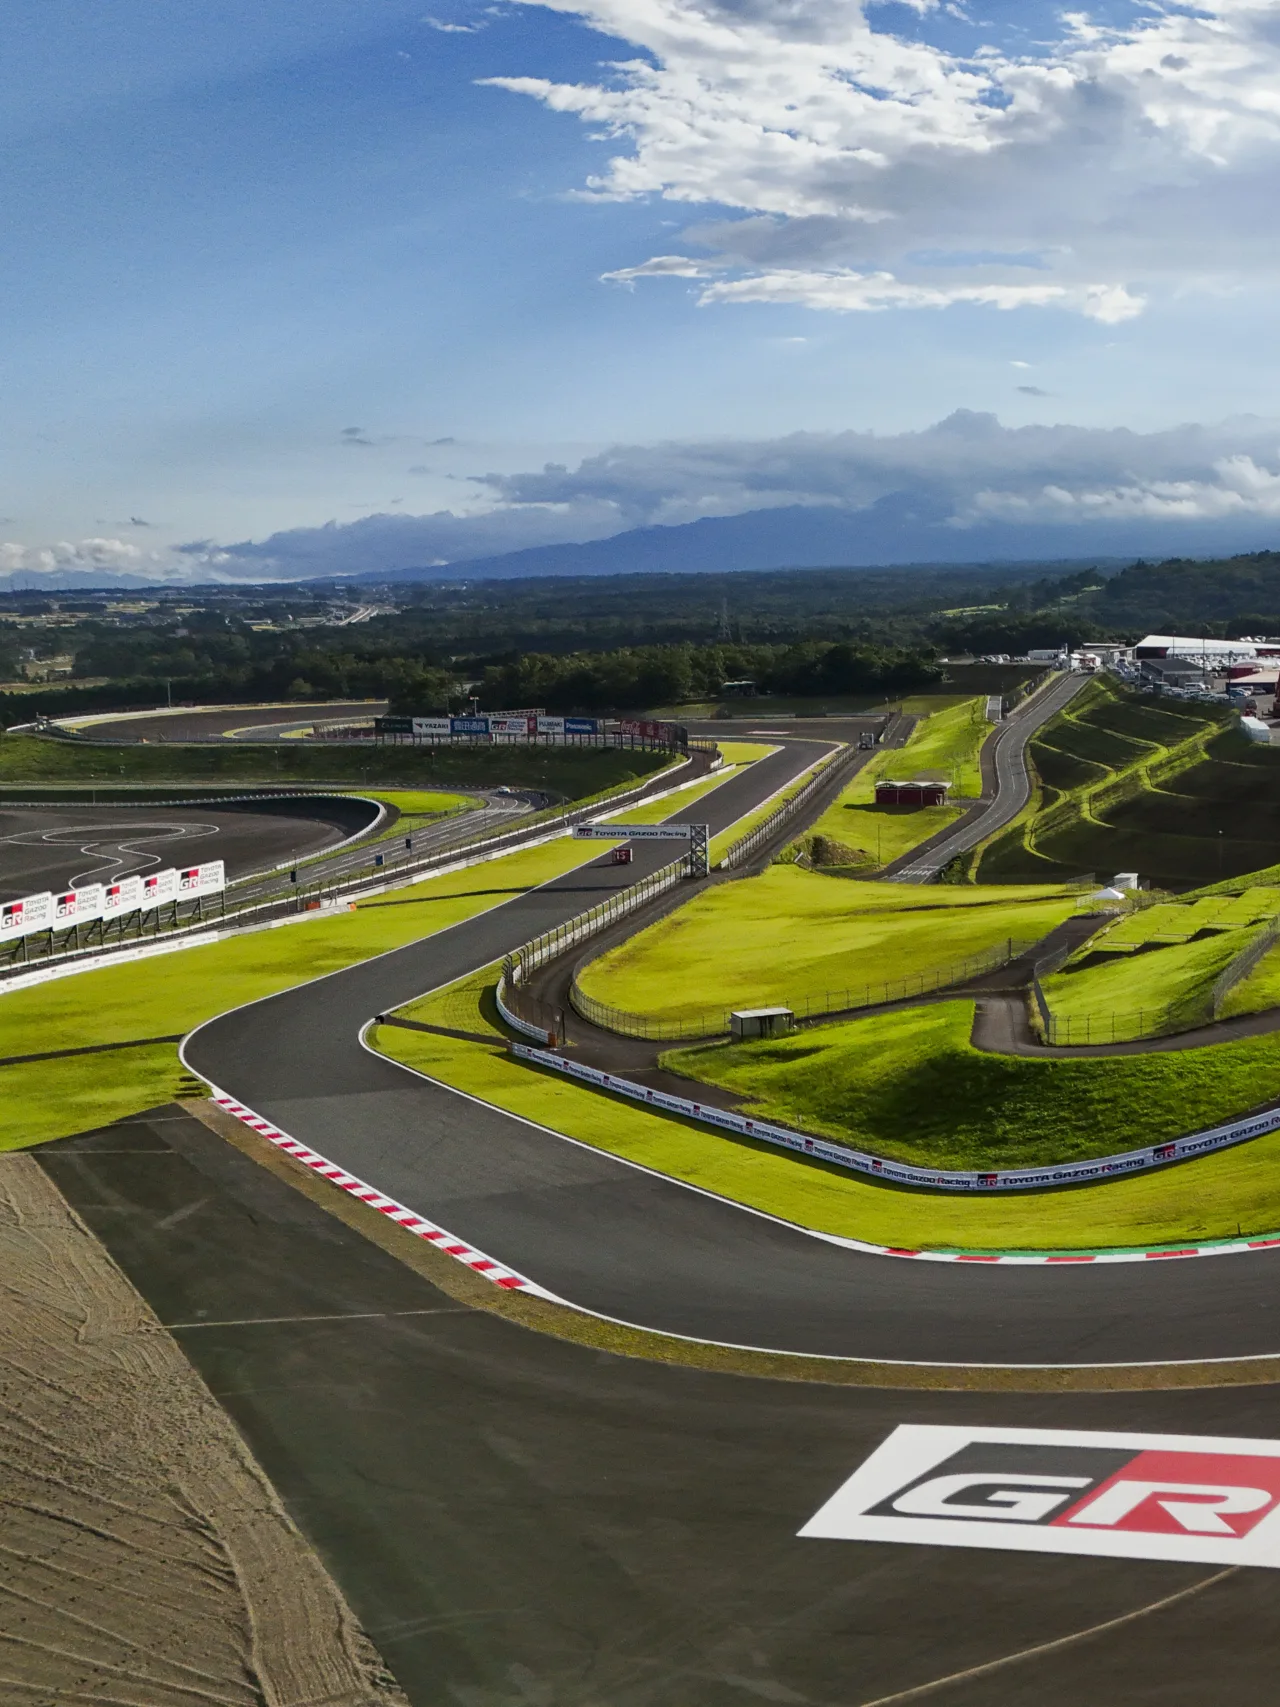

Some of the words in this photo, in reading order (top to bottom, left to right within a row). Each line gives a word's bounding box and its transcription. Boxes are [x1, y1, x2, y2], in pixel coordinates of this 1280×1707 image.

[660, 830, 687, 838] Racing
[179, 876, 199, 891] GR
[25, 896, 49, 907] TOYOTA
[105, 894, 120, 909] GR
[143, 886, 157, 900] GR
[56, 901, 76, 918] GR
[1, 912, 22, 930] GR
[1179, 1135, 1227, 1153] TOYOTA
[1230, 1121, 1268, 1139] GAZOO
[883, 1168, 906, 1178] TOYOTA
[907, 1173, 935, 1183] GAZOO
[937, 1177, 970, 1187] Racing
[1001, 1175, 1049, 1184] TOYOTA
[1052, 1167, 1098, 1180] GAZOO
[1101, 1158, 1144, 1173] Racing
[892, 1473, 1272, 1535] GR
